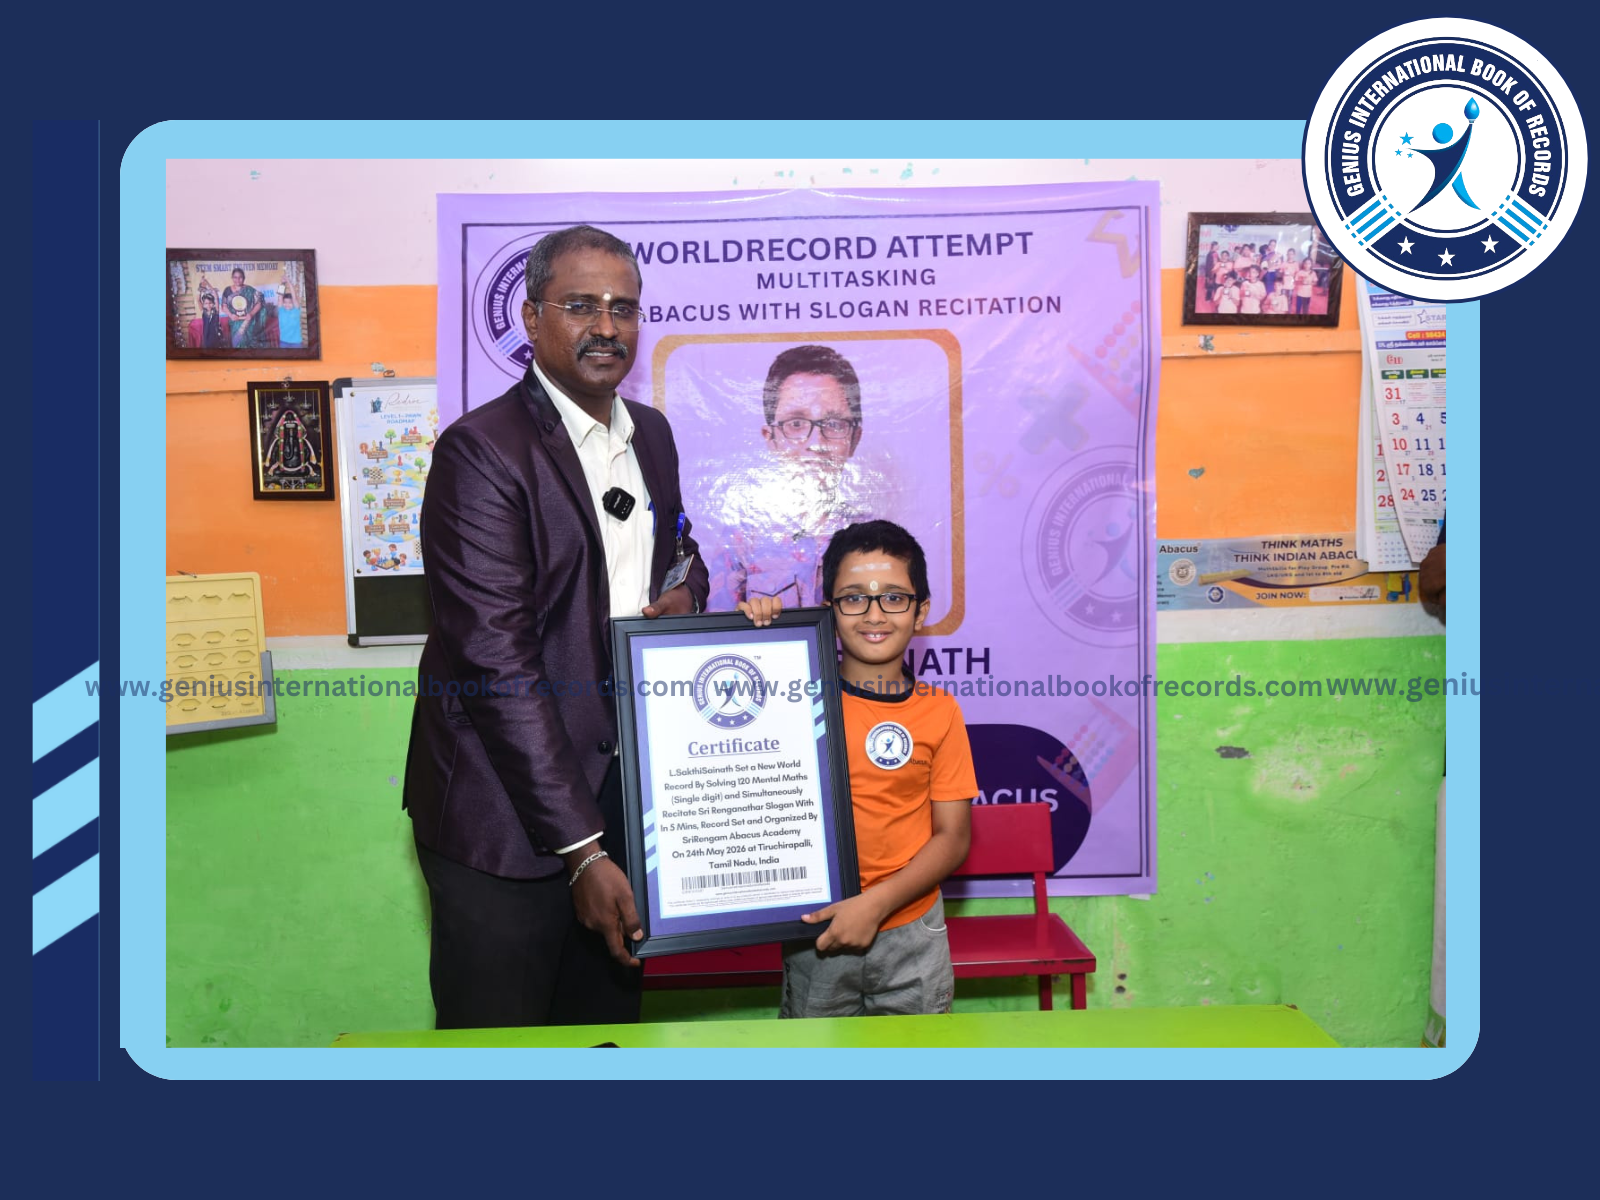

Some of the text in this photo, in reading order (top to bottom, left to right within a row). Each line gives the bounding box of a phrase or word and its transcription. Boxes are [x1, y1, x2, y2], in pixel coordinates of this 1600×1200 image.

[628, 231, 1034, 265] WORLDRECORD ATTEMPT
[756, 268, 937, 290] MULTITASKING
[492, 257, 528, 330] GENIUS INTERNA
[739, 301, 801, 321] WITH
[809, 299, 910, 320] SLOGAN
[919, 295, 1063, 317] RECITATION
[1385, 387, 1401, 400] 31
[1392, 412, 1446, 425] 3 4 5
[1392, 438, 1407, 450] 10
[1415, 438, 1430, 450] 11
[1396, 463, 1410, 475] 17
[1418, 463, 1434, 476] 18
[1377, 495, 1395, 507] 28
[1400, 488, 1415, 500] 24
[1421, 489, 1437, 501] 25
[1047, 472, 1129, 577] GENIUS INTERNATIONAL
[1159, 545, 1198, 553] Abacus
[1261, 538, 1343, 550] THINK MATHS
[1234, 554, 1270, 563] THINK
[1273, 552, 1316, 562] INDIAN
[1256, 592, 1277, 600] JOIN
[1280, 591, 1307, 599] NOW:
[687, 737, 780, 756] Certificate
[669, 763, 734, 777] L.SakthiSainath
[735, 764, 749, 773] Set
[777, 759, 801, 769] World
[664, 773, 808, 791] Record By Solving 120 Mental Maths
[671, 787, 803, 806] (Single digit) and Simultaneously
[662, 798, 814, 819] Recitate Sri Renganathar Slogan With
[660, 824, 668, 832] In
[677, 821, 699, 831] Mins,
[701, 819, 730, 829] Record
[731, 818, 746, 826] Set
[747, 816, 763, 825] and
[764, 812, 807, 825] Organized
[808, 812, 818, 821] By
[682, 828, 801, 845] SriRengam Abacus Academy
[672, 839, 813, 859] On 24th May 2026 at Tiruchirapalli,
[708, 856, 780, 870] Tamil Nadu, India
